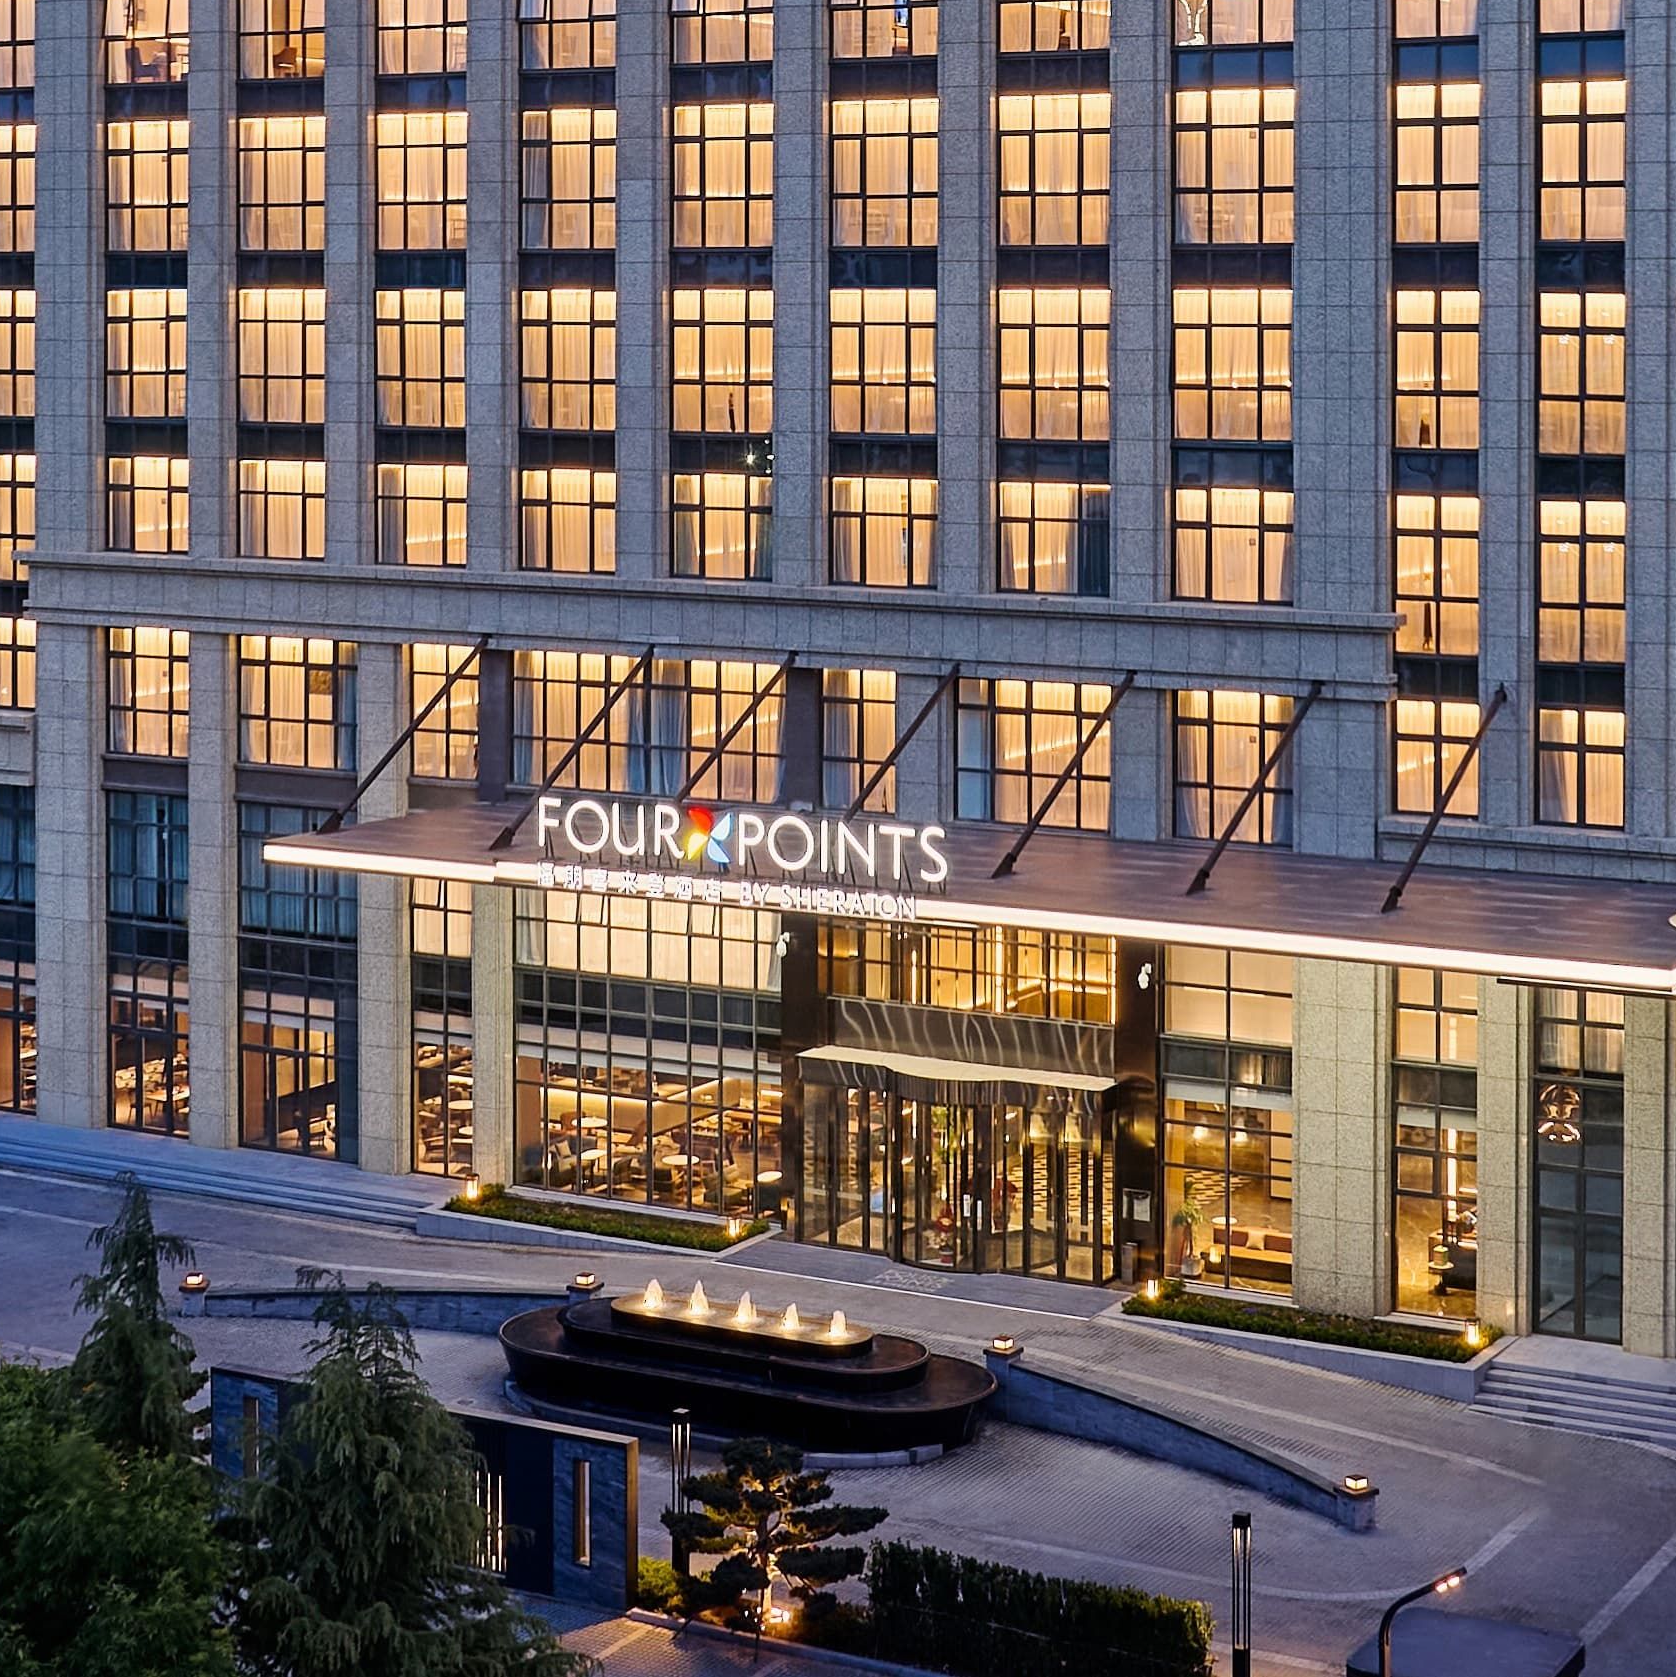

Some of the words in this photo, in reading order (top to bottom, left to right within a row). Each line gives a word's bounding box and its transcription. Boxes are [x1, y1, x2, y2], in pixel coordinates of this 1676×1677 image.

[537, 796, 685, 860] FOUR
[737, 813, 949, 883] POINTS
[739, 880, 770, 907] BY
[780, 883, 916, 922] SHERATON
